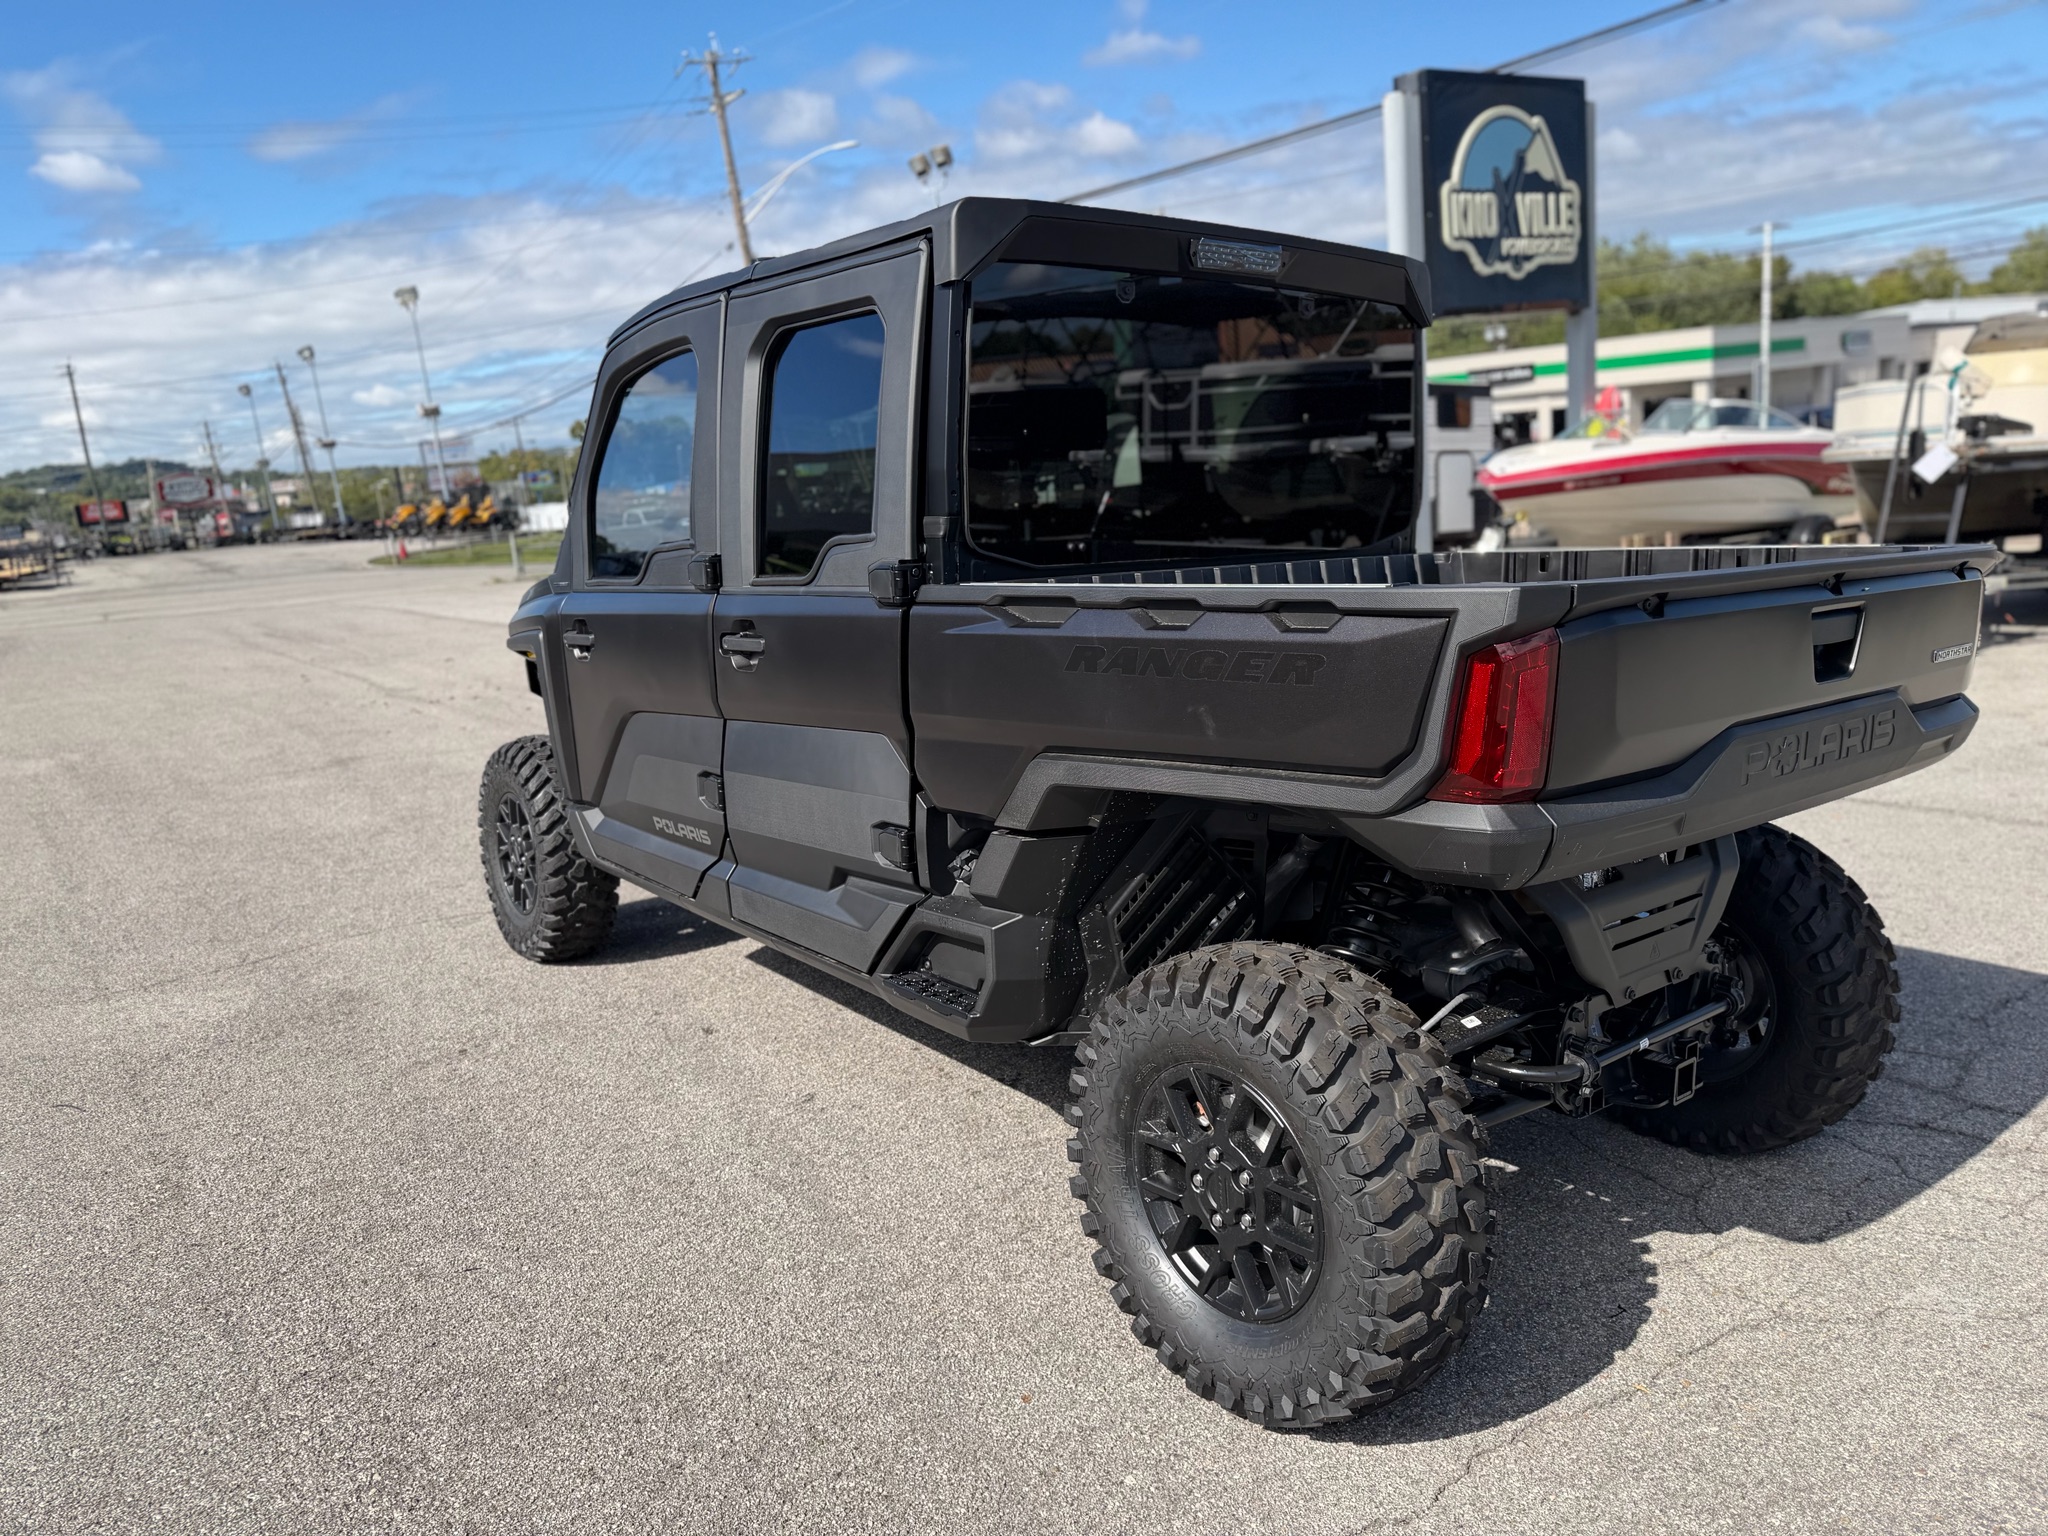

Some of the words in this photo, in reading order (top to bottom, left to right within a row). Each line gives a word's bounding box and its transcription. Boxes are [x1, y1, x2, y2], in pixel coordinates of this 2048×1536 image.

[1063, 644, 1327, 686] RANGER
[1938, 646, 1972, 660] NORTHSTAR
[1740, 709, 1896, 786] POLARIS
[652, 815, 712, 846] POLARIS
